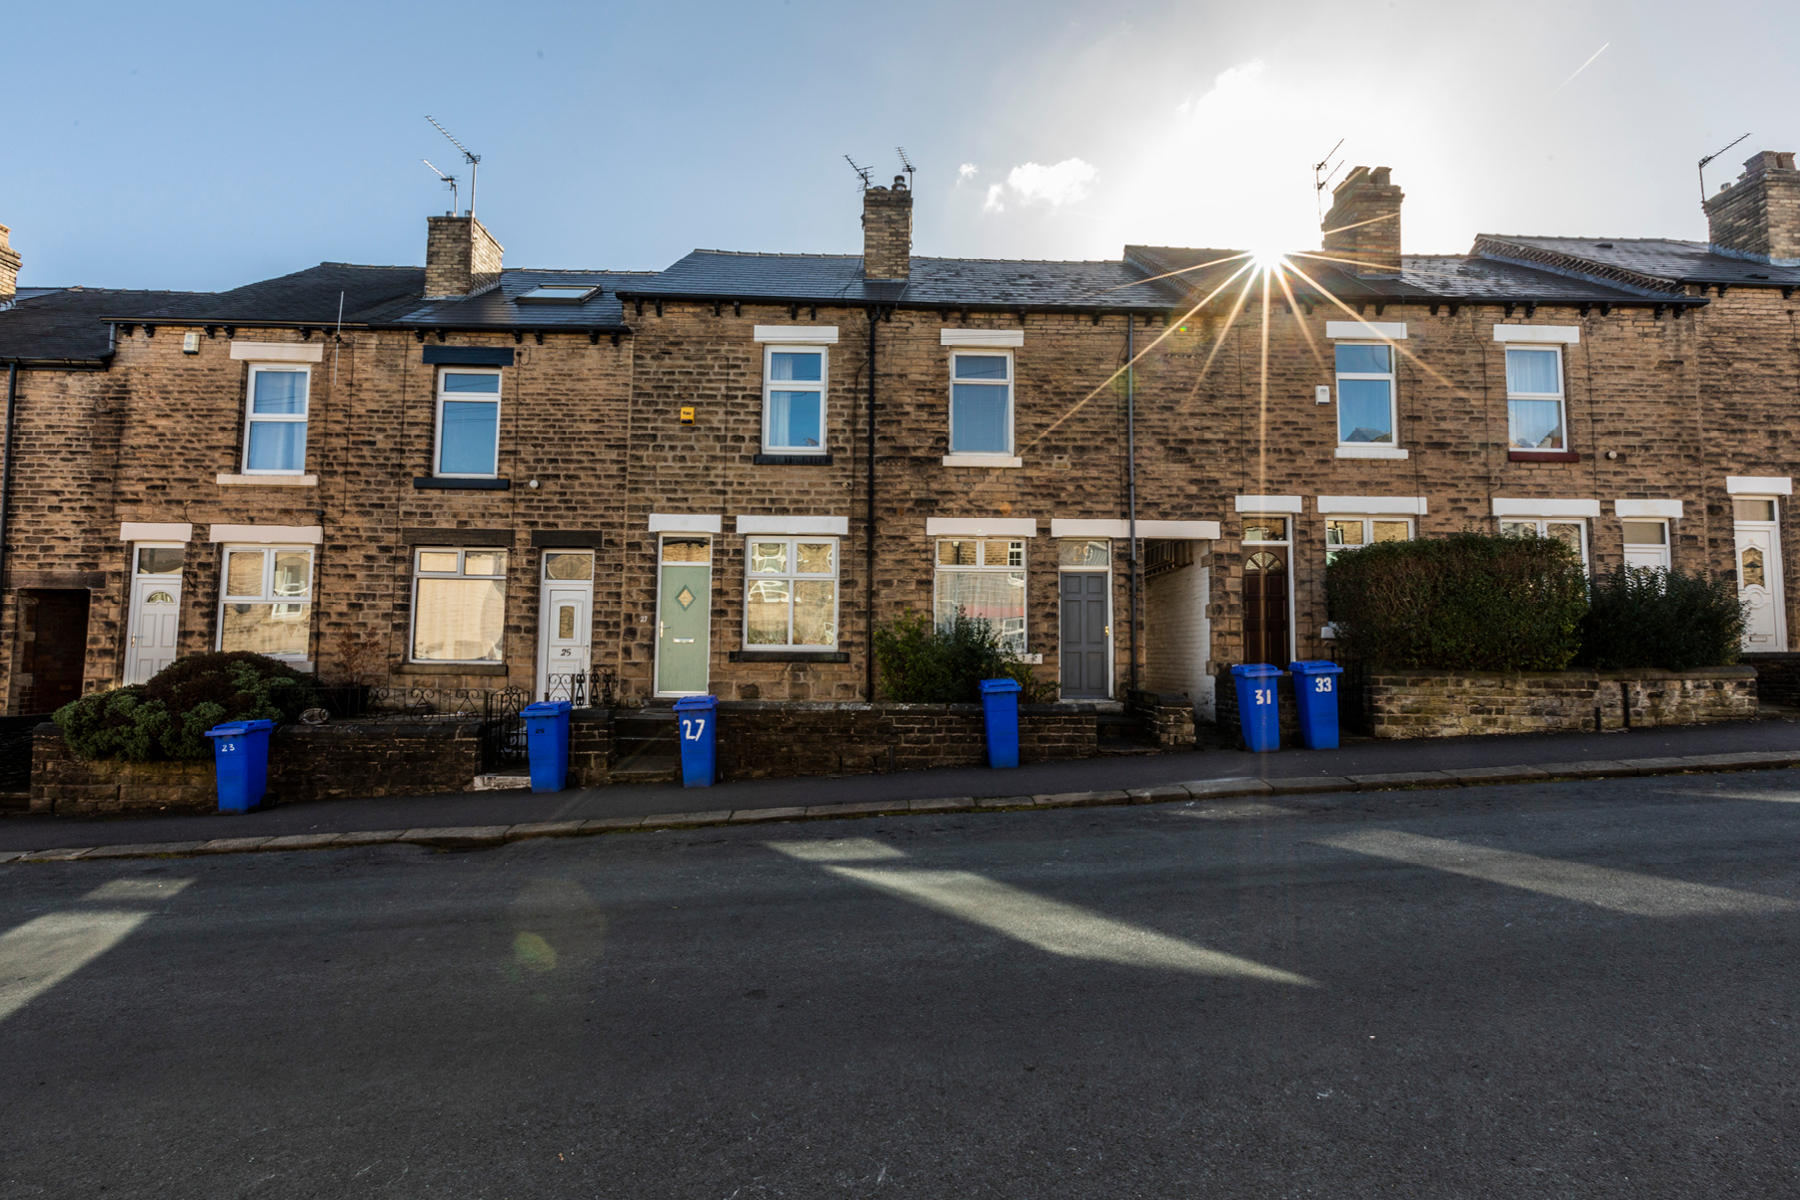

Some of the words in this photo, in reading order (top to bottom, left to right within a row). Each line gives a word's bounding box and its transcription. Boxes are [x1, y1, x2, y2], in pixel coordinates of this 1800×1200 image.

[1073, 545, 1093, 562] 29
[640, 615, 648, 623] 27
[560, 648, 571, 657] 25
[1315, 677, 1332, 693] 33
[1254, 689, 1272, 705] 31
[682, 719, 705, 741] 27
[221, 743, 235, 752] 23
